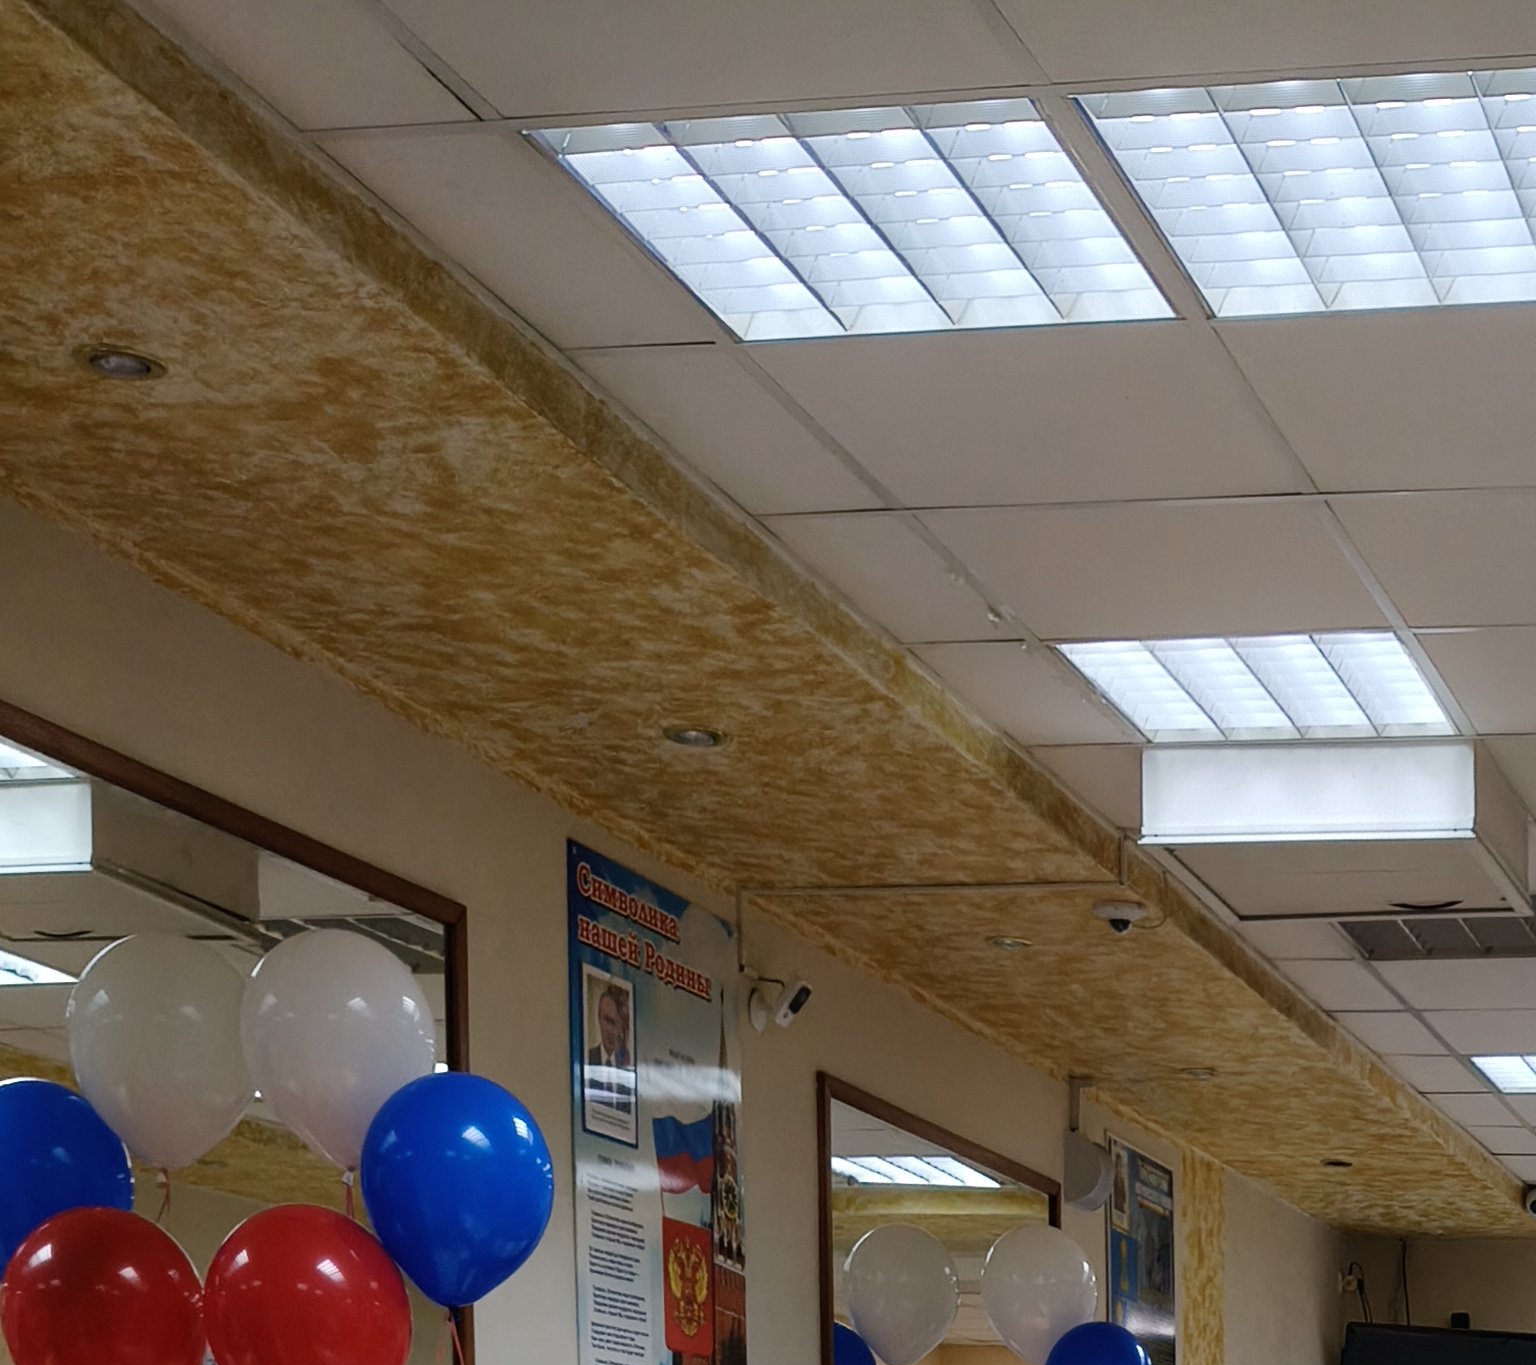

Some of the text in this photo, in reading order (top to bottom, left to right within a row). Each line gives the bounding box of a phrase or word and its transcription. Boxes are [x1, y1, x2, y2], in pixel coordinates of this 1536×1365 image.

[577, 862, 681, 942] Символика
[578, 915, 711, 1001] нашей Родины
